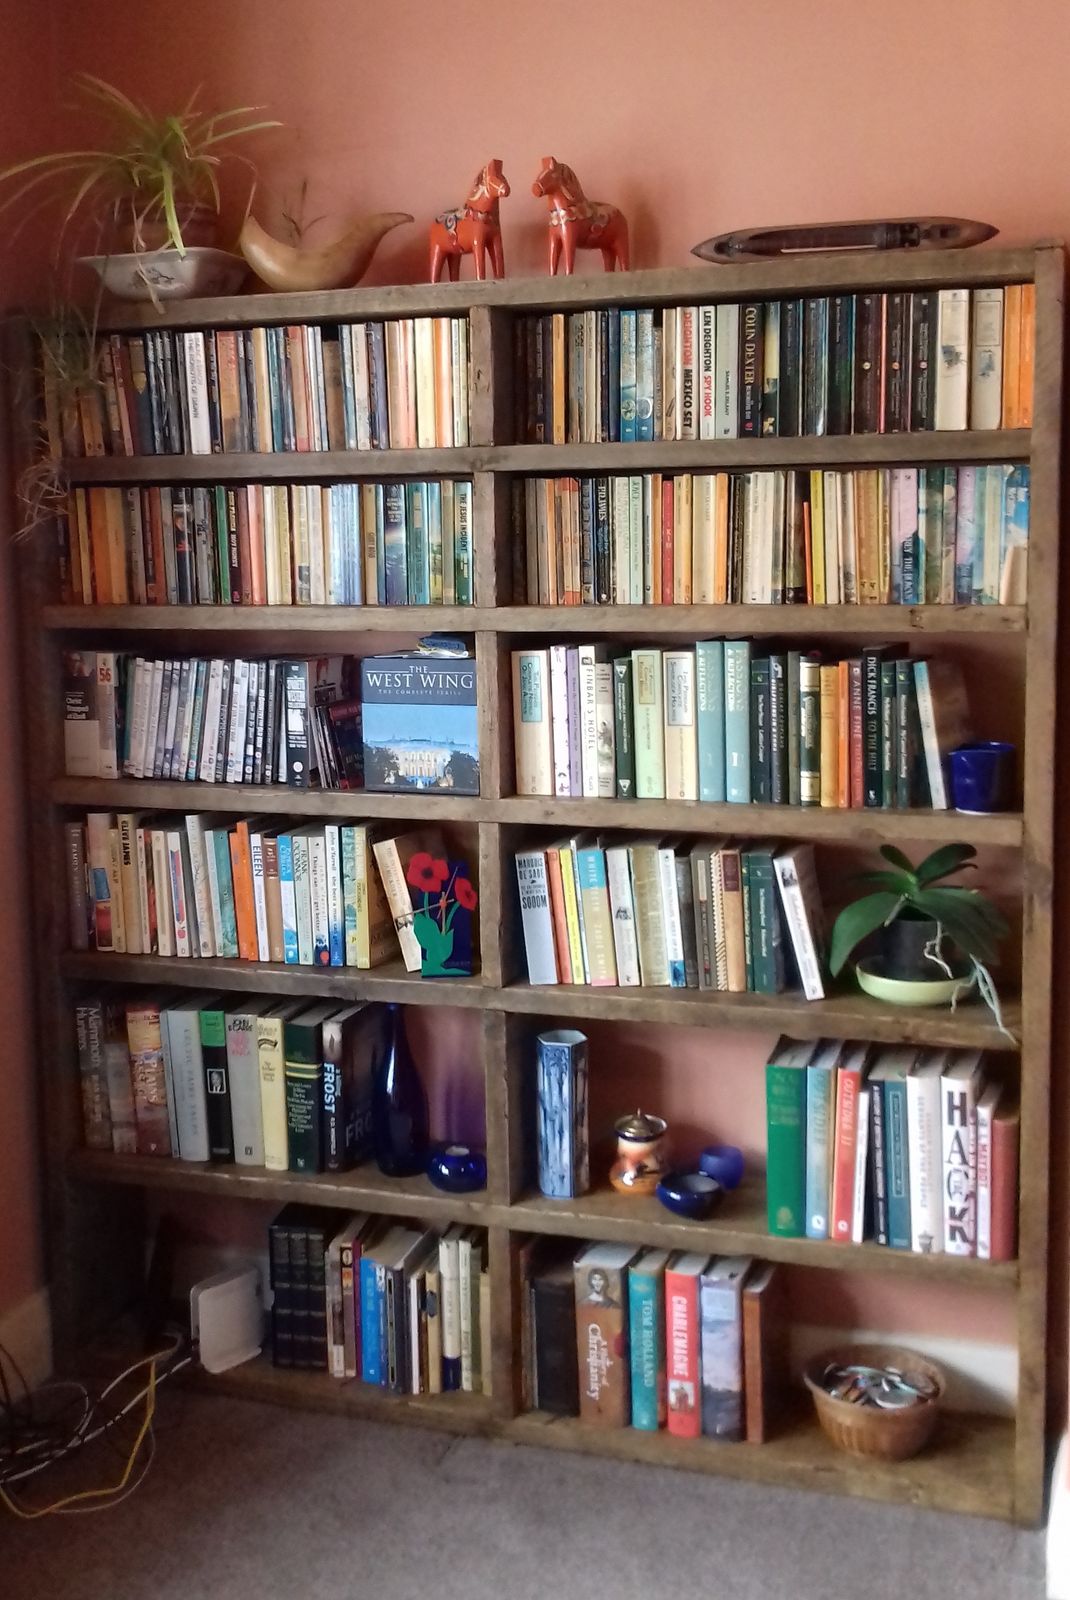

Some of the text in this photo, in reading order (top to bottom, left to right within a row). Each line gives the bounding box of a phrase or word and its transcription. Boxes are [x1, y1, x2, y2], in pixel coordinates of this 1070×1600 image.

[703, 311, 712, 417] LEN DEIGHTON SPY HOOK
[744, 307, 757, 385] COLIN DEXTER
[683, 312, 694, 429] DEIGHTON MEXICO SET
[632, 480, 641, 502] JOYCE
[459, 493, 468, 552] THE JESUS INCIDENT
[99, 667, 112, 682] 56
[367, 673, 475, 689] WEST WING
[409, 665, 428, 673] THE
[698, 657, 706, 712] REFLECTIONS
[727, 657, 736, 713] REFLECTIONS
[735, 649, 747, 712] PASSIONS
[853, 680, 862, 739] ANNE FINE
[867, 656, 877, 771] DICK FRANCIS TO THE HILT
[121, 820, 132, 866] CLIVE JAMES
[252, 845, 264, 877] EILEEN
[329, 832, 337, 846] john
[330, 846, 338, 871] o'farrell
[312, 855, 320, 876] Things
[517, 858, 544, 869] MARQUIS
[519, 868, 544, 880] DE SADE
[588, 855, 598, 885] WHITE
[522, 894, 548, 910] SODOM
[595, 924, 604, 949] ZADIE
[598, 953, 607, 980] SMITH
[76, 1006, 88, 1051] Hunters
[88, 1006, 102, 1068] Mammoth
[147, 1060, 159, 1104] PLAINS
[323, 1062, 336, 1113] FROST
[839, 1077, 854, 1131] OUTSIDER
[642, 1299, 656, 1388] TOM HOLLAND
[671, 1295, 689, 1378] CHARLEMAGNE
[586, 1322, 602, 1401] Christianity
